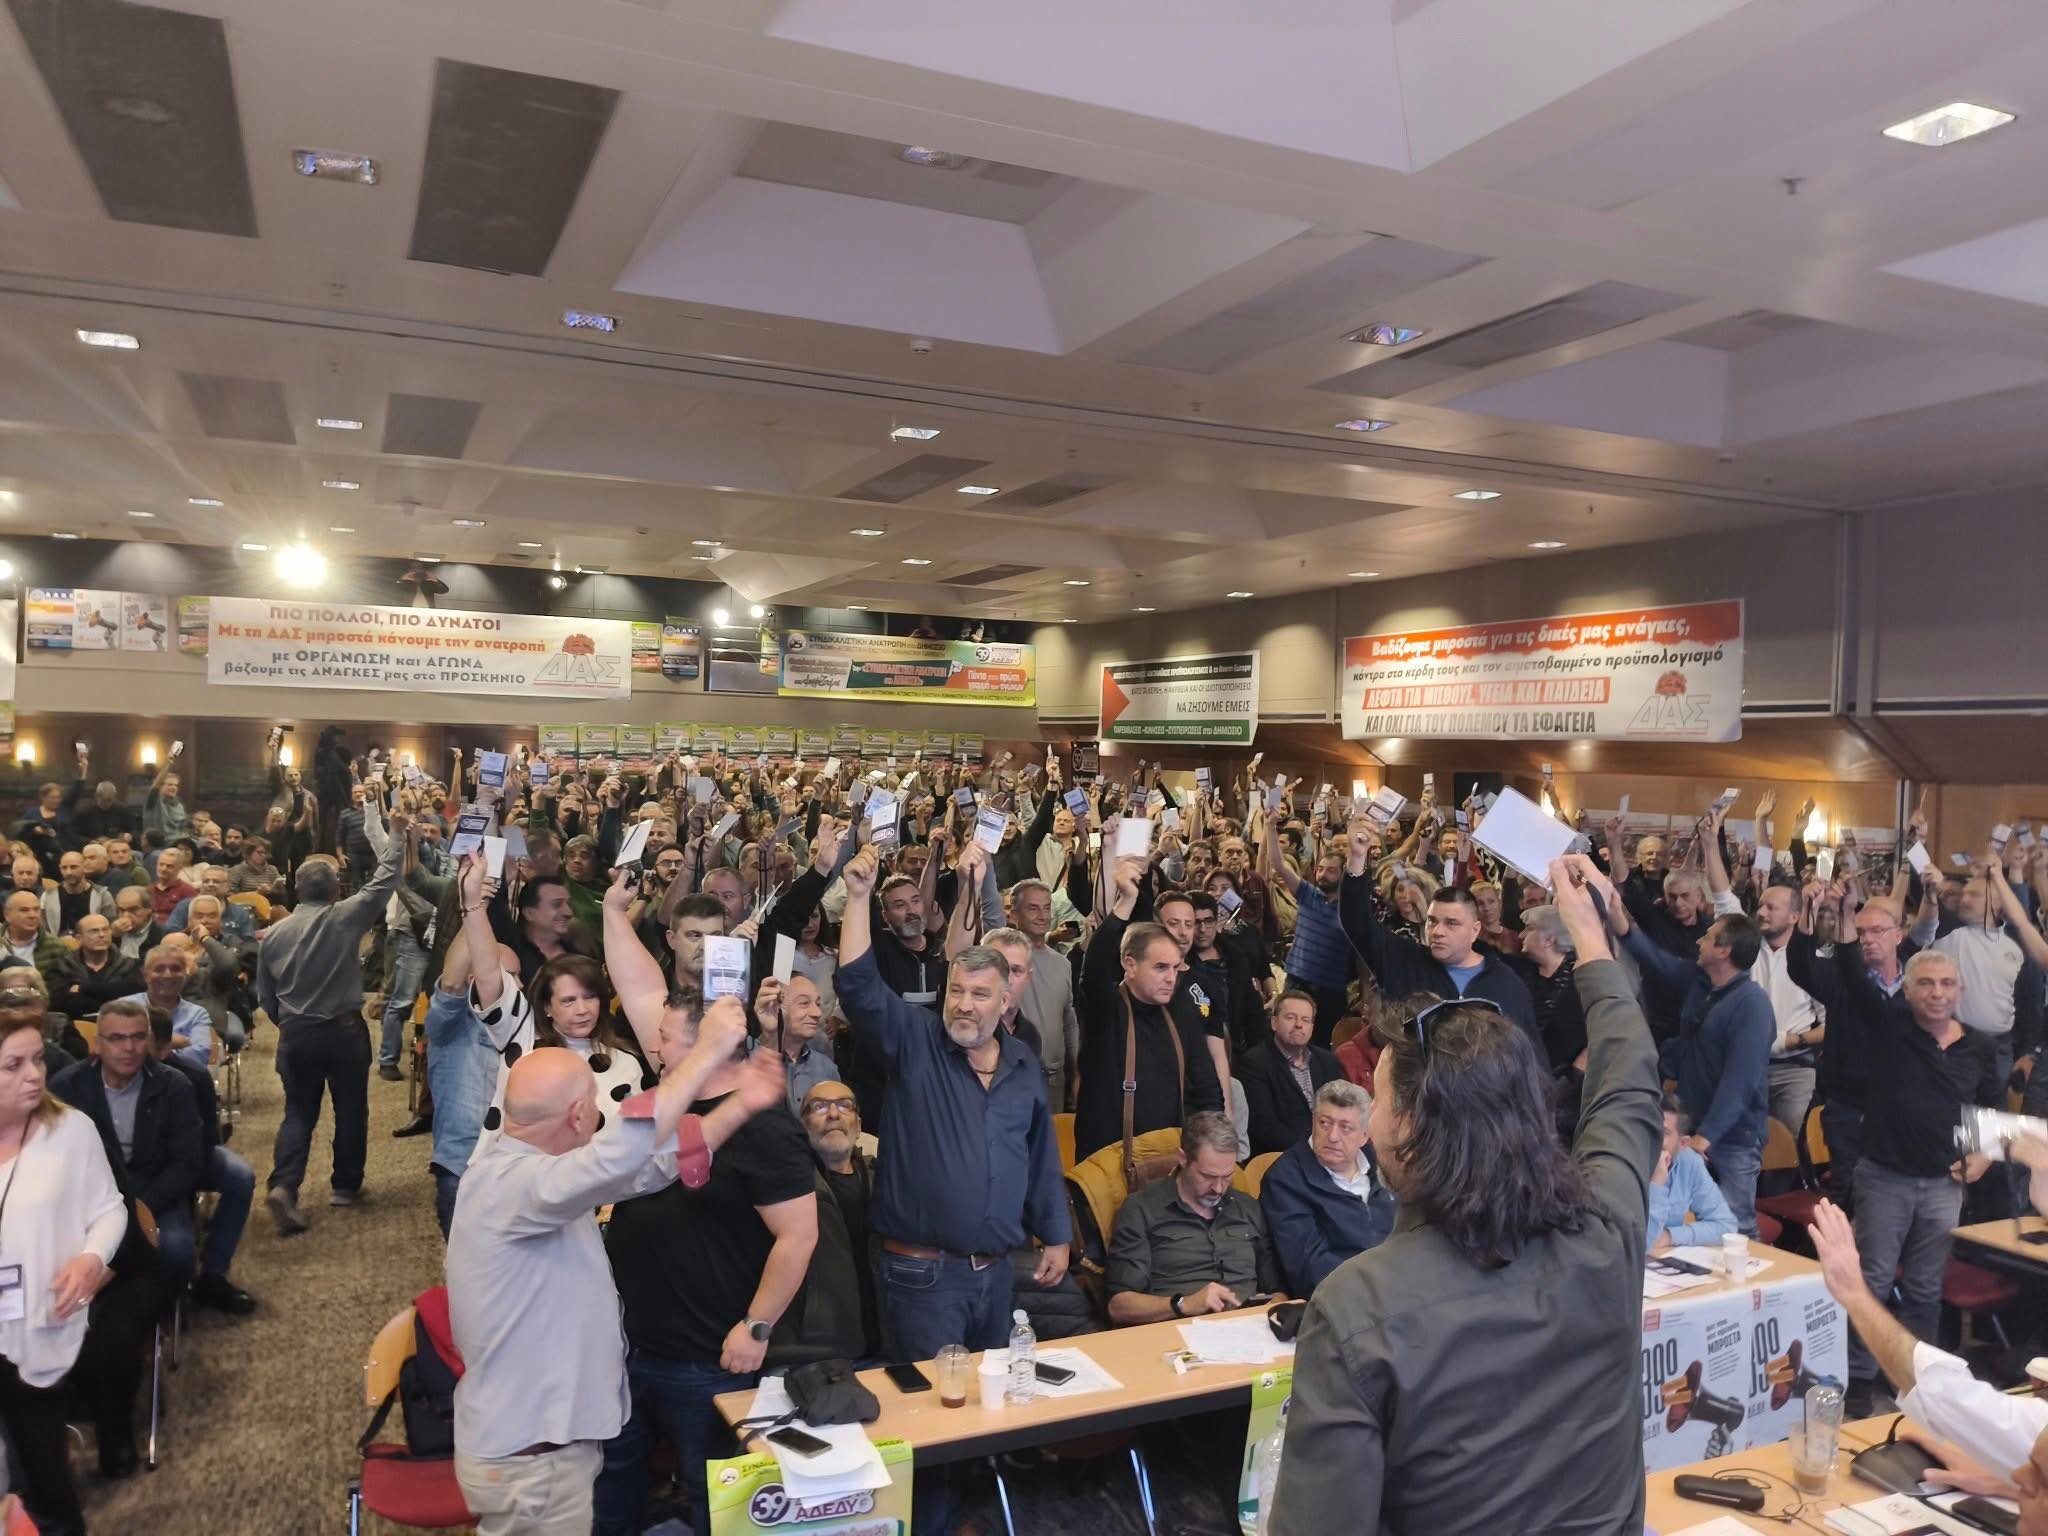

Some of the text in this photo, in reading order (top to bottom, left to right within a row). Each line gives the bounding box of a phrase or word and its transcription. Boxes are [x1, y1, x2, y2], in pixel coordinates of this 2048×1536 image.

[270, 606, 501, 631] ΠΙΟ ΠΟΛΛΟΙ, ΠΙΟ ΔΥΝΑΤΟΙ
[218, 624, 546, 654] Με τη ΔΑΣ μπροστά κάνουμε την ανατροπή
[1372, 616, 1691, 657] Βαδίζουμε μπροστά για τις δικές μας ανάγκες,
[224, 661, 526, 684] βάζουμε τις ΑΝΑΓΚΕΣ μας στο ΠΡΟΣΚΗΝΙΟ
[272, 650, 484, 669] με ΟΡΓΑΝΩΣΗ και ΑΓΩΝΑ
[534, 653, 621, 685] ΔΑΣ
[1353, 668, 1385, 684] κόντρα
[1405, 663, 1435, 679] κέρδη
[1437, 665, 1460, 677] τους
[1462, 664, 1480, 673] και
[1483, 663, 1502, 673] τον
[1605, 645, 1724, 670] προϋπολογισμό
[1516, 680, 1542, 704] ΚΑΙ
[1544, 678, 1606, 703] ΠΑΙΔΕΙΑ
[1176, 700, 1251, 713] ΝΑ ΖΗΣΟΥΜΕ ΕΜΕΙΣ
[1628, 694, 1712, 729] ΔΑΣ
[1365, 711, 1596, 733] ΚΑΙ ΟΧΙ ΓΙΑ ΤΟΥ ΠΟΛΕΜΟΥ ΤΑ ΣΦΑΓΕΙΑ
[753, 1490, 786, 1520] 39
[795, 1498, 858, 1520] ΑΔΕΔΥ
